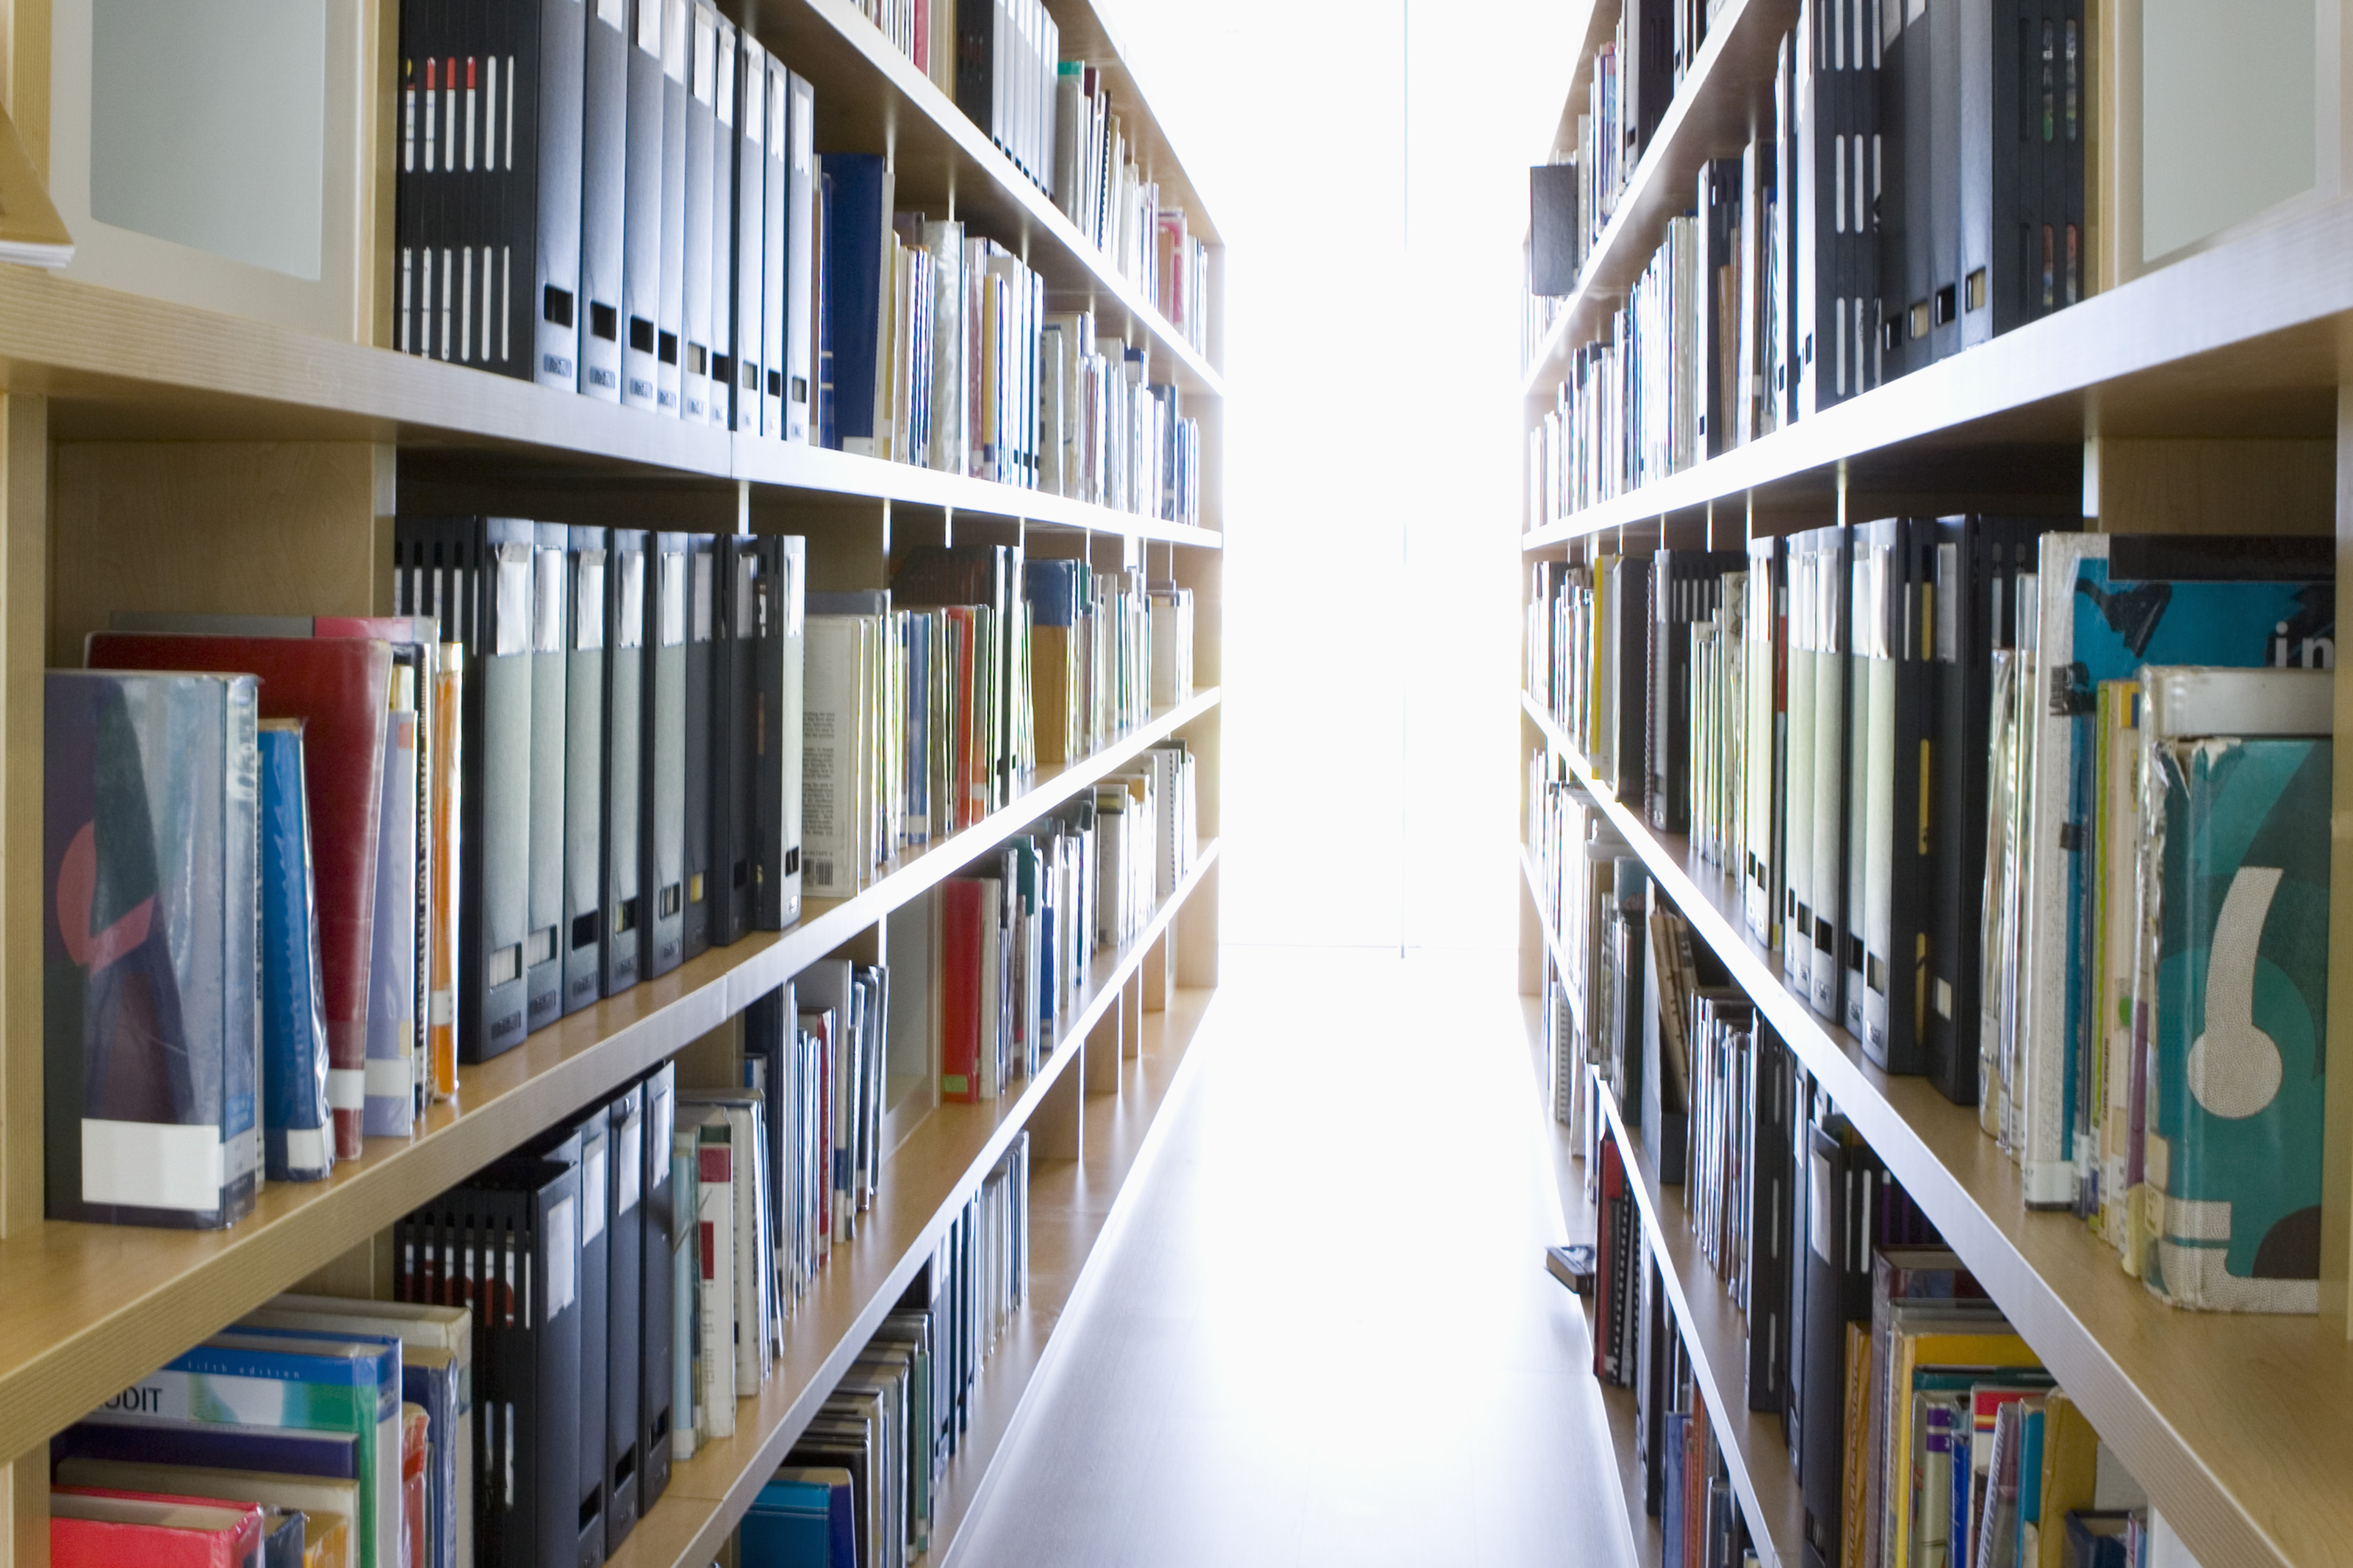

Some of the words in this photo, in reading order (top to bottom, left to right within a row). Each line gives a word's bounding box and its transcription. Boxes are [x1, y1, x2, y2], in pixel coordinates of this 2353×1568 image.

[187, 1360, 227, 1373] fifth
[239, 1367, 299, 1379] edition
[99, 1385, 163, 1412] UDIT
